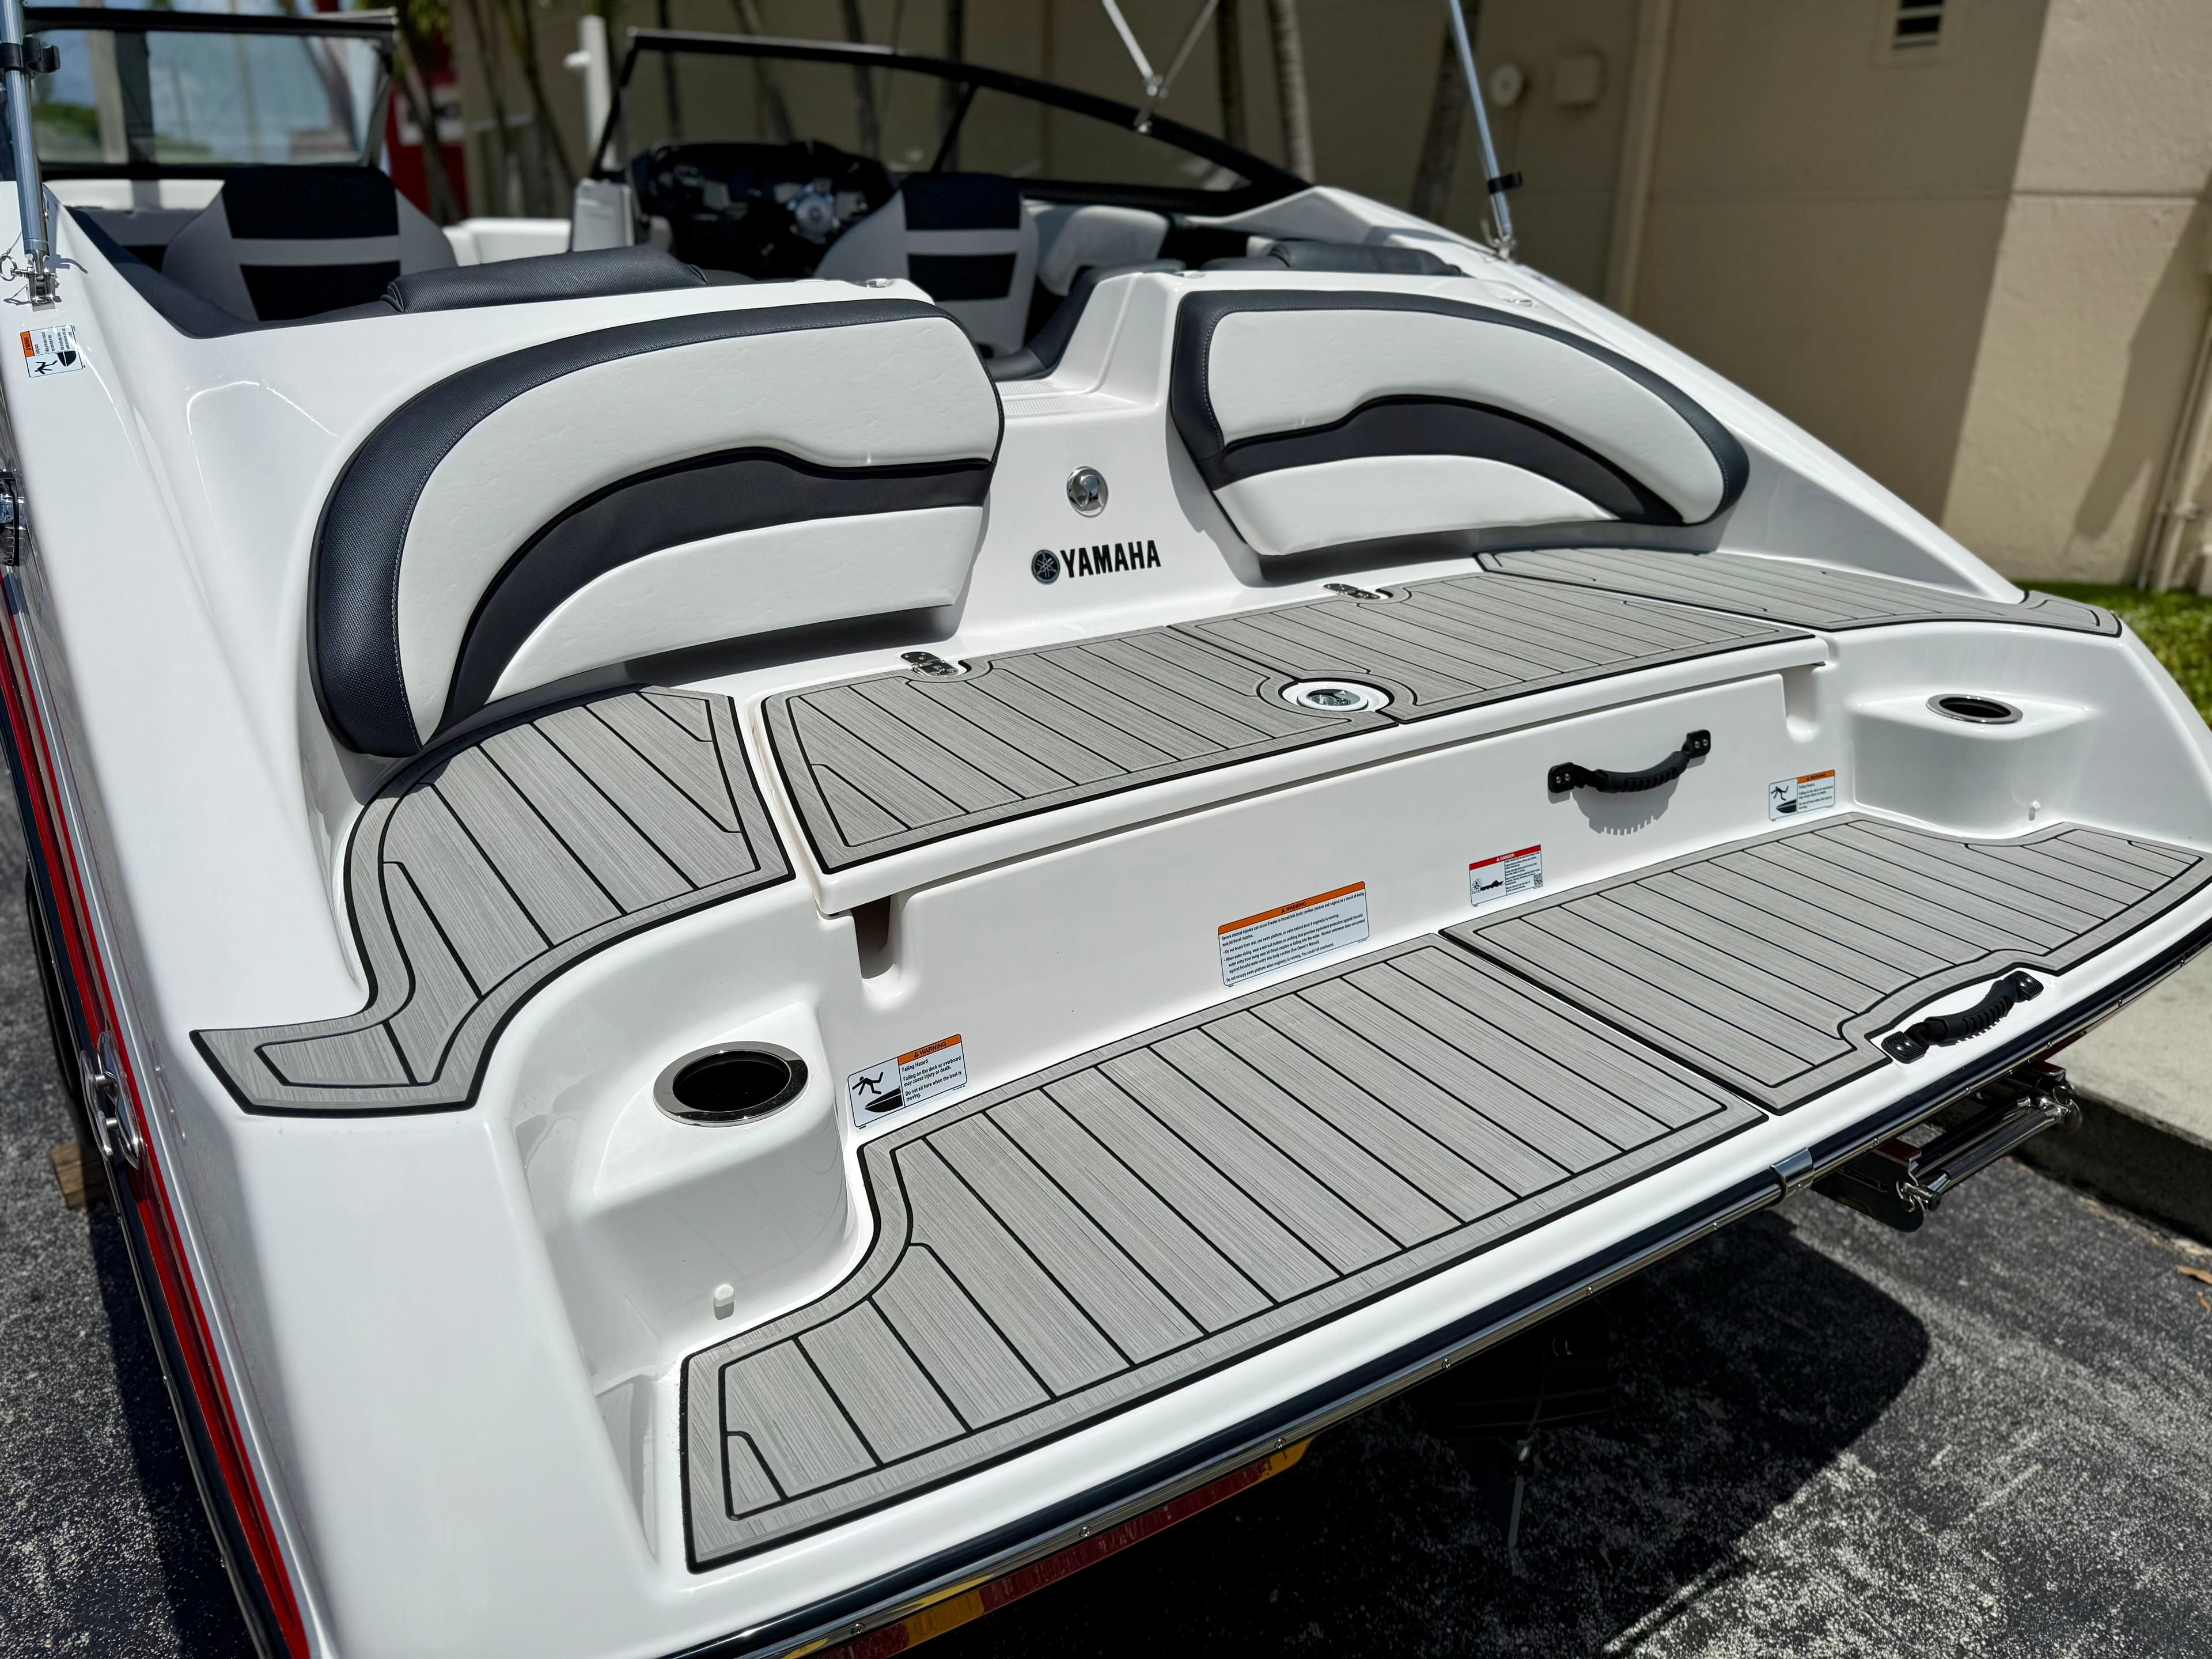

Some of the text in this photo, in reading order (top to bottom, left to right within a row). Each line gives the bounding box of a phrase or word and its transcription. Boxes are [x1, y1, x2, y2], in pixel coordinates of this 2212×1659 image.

[1060, 540, 1161, 578] YAMAHA
[1286, 902, 1306, 911] WARNING
[920, 1041, 946, 1056] WARNING
[943, 1055, 961, 1066] overboard
[902, 1065, 914, 1073] Falling
